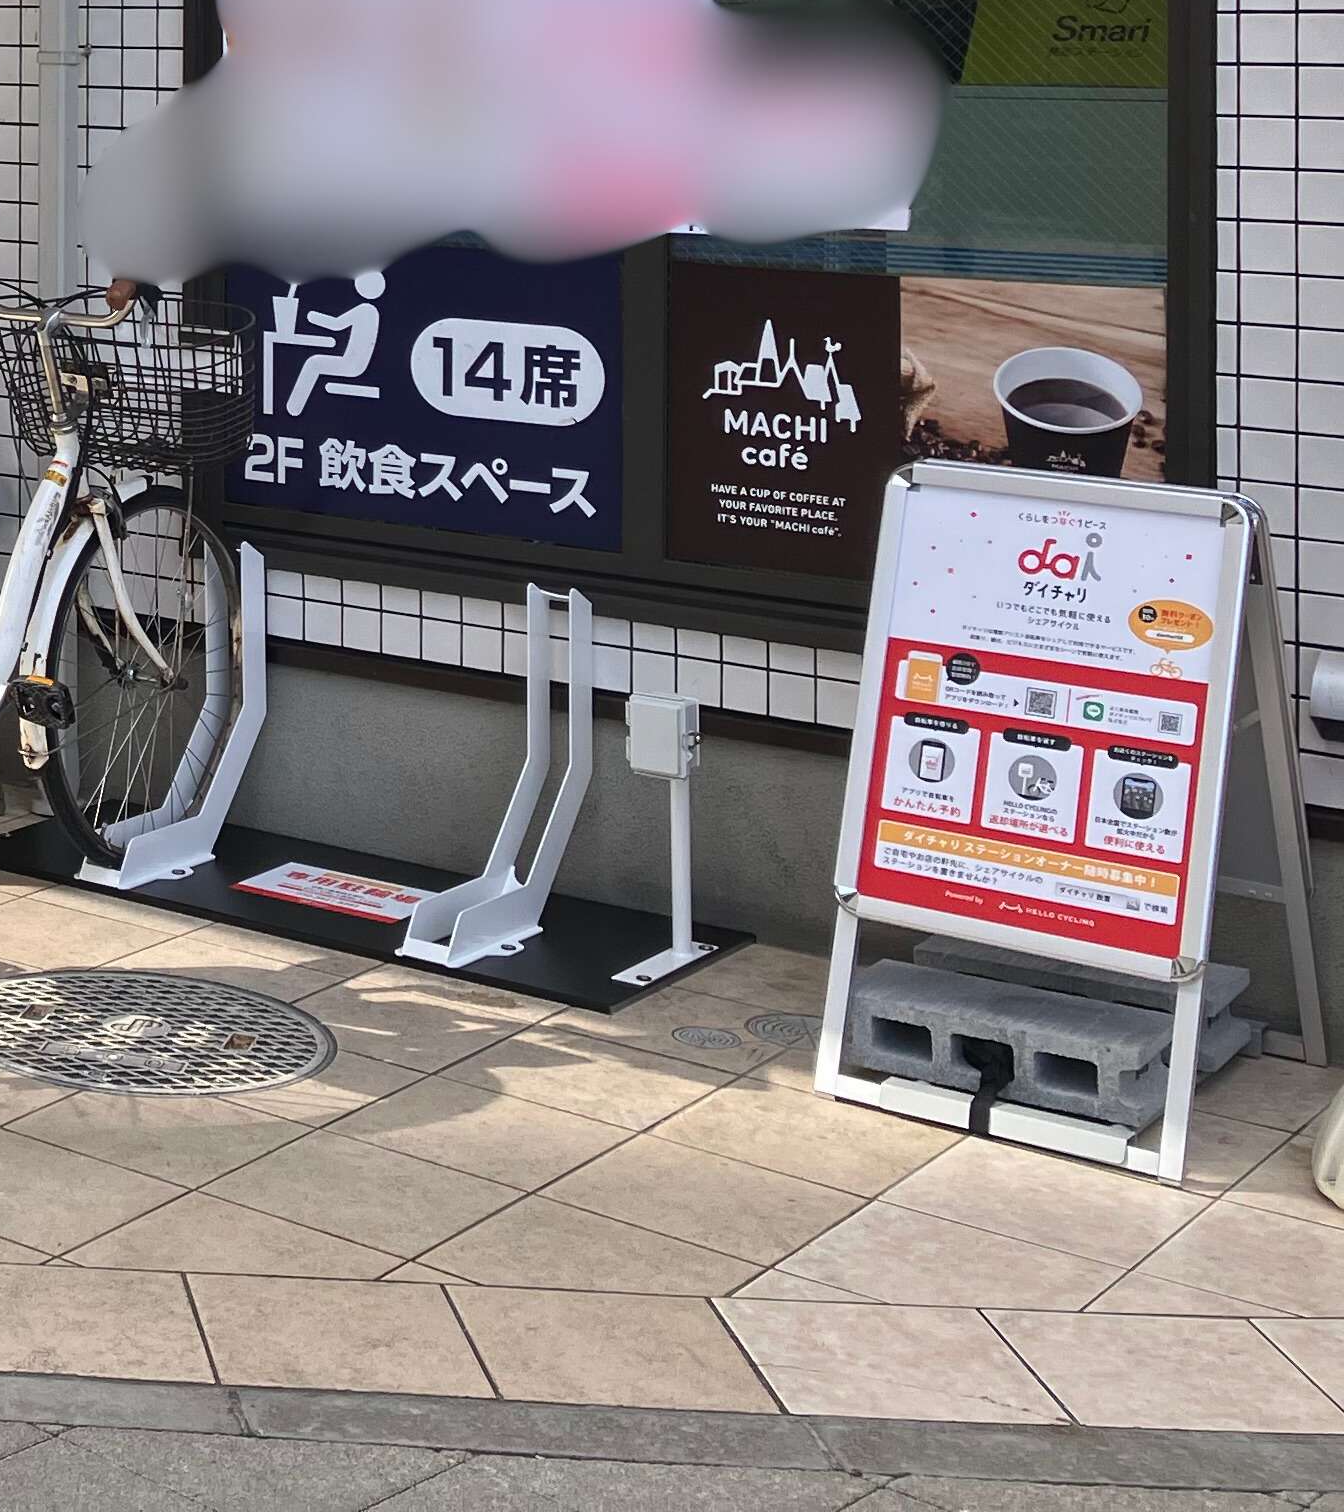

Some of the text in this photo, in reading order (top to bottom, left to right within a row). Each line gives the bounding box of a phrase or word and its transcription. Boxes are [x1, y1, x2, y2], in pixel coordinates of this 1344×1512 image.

[1052, 15, 1152, 43] Smari
[433, 336, 581, 409] 14席
[724, 408, 828, 444] MACHI
[741, 444, 809, 470] café
[245, 433, 597, 519] 2F 飲食スペース
[711, 483, 847, 507] HAVE A CUP OF COFFEE AT
[717, 513, 737, 524] IT'S
[740, 516, 768, 528] YOUR
[719, 499, 838, 521] YOUR FAVORITE PLACE.
[1023, 580, 1087, 603] ダイチャリ
[996, 600, 1111, 624] いつでもどこでも気軽に使える
[1027, 615, 1080, 632] シェアサイクル
[893, 796, 961, 818] かんたん予約
[903, 829, 960, 853] ダイチャリ
[1103, 835, 1166, 855] 便利に使える
[1025, 906, 1095, 928] HELLO CYCLING
